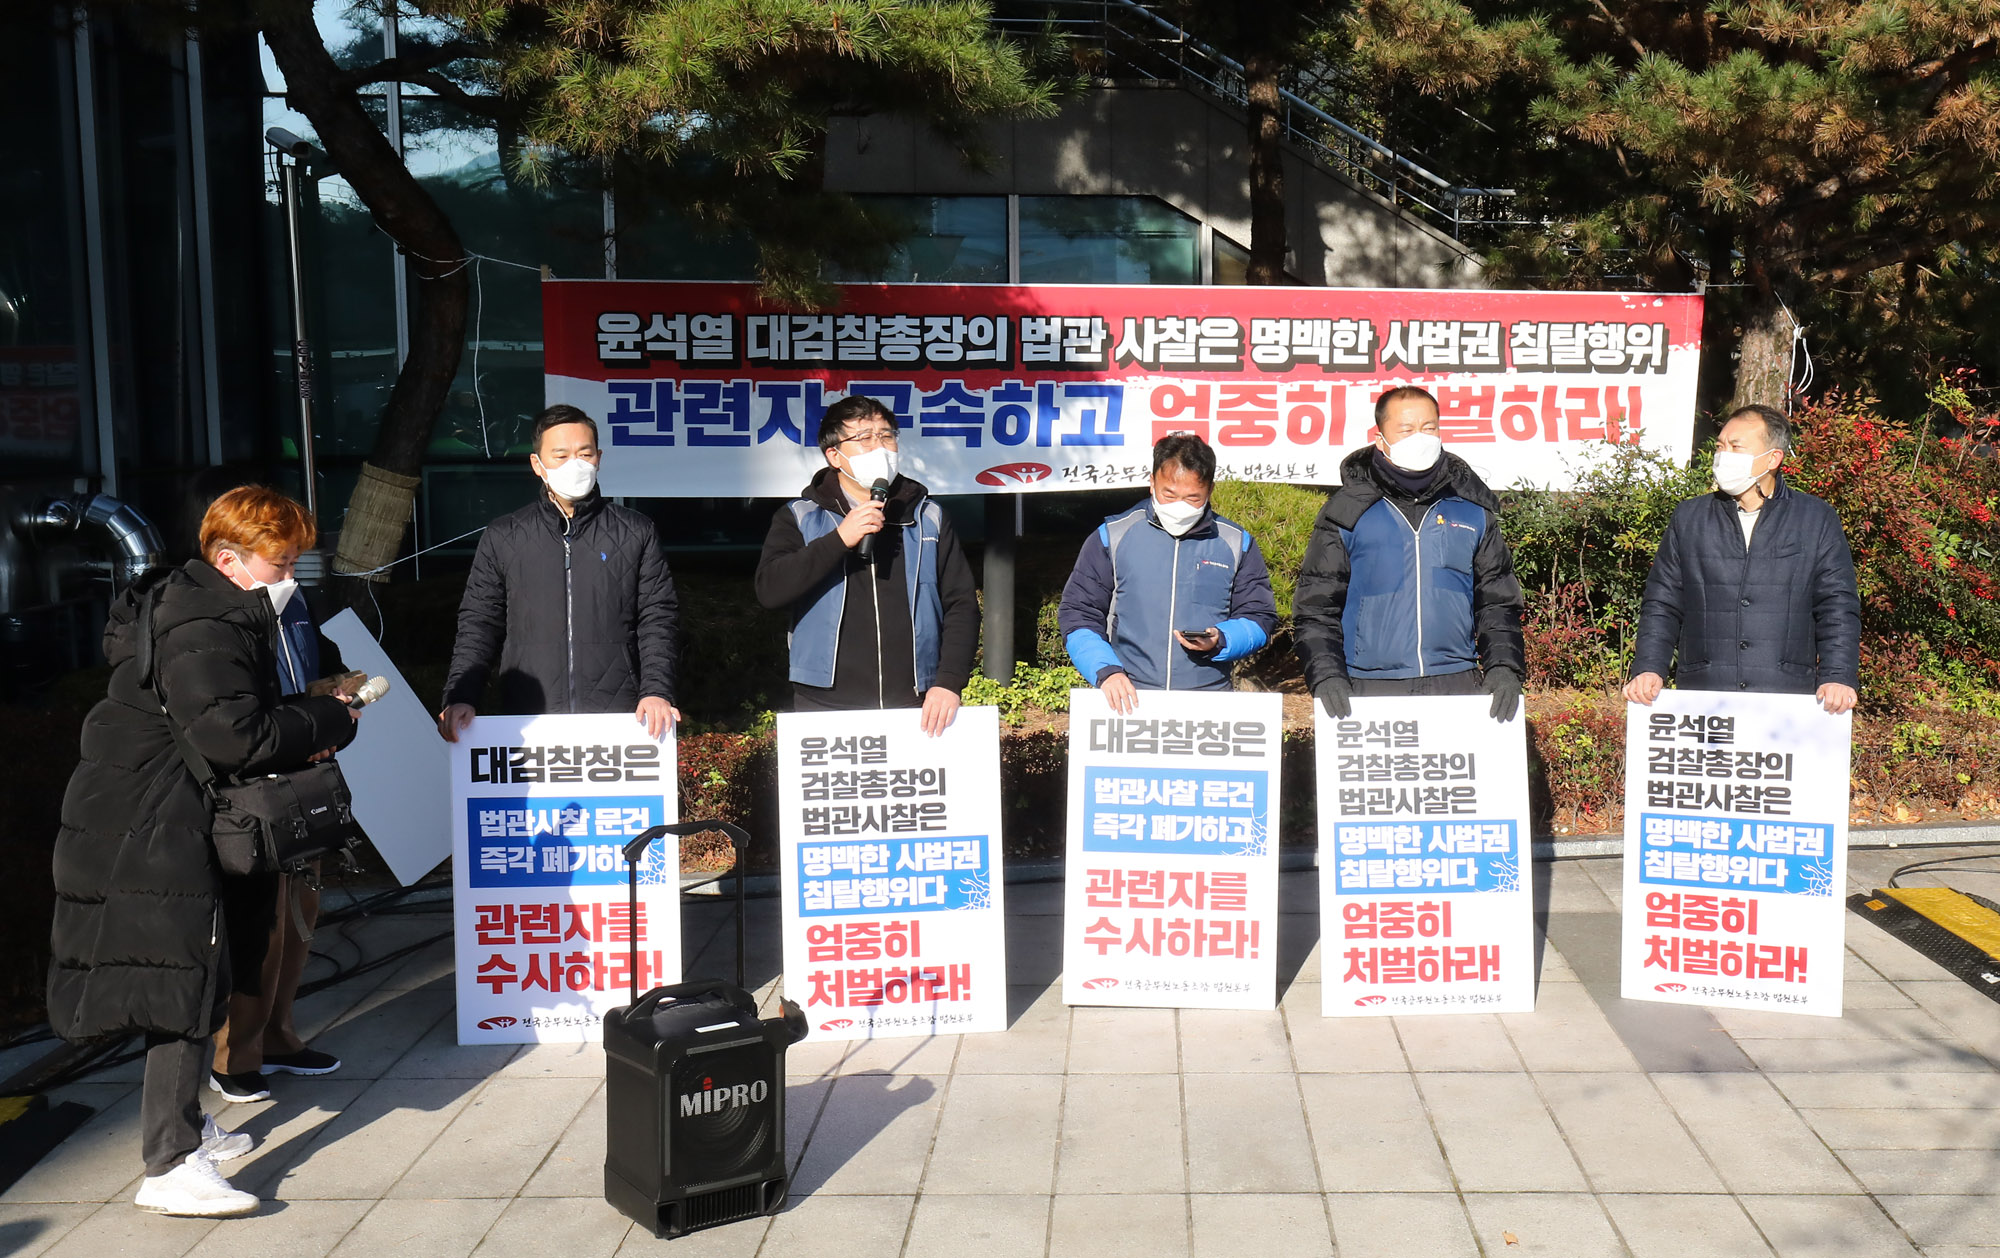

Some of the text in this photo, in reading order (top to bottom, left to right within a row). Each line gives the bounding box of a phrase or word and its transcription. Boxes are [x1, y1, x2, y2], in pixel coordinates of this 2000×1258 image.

[598, 313, 1663, 368] 윤석열 대검찰총장의 법관 사찰은 명백한 사법권 침탈행위
[607, 382, 820, 448] 관련자
[1150, 385, 1346, 447] 엄중히
[1366, 385, 1642, 445] 벌하라!
[1245, 463, 1320, 480] 법원본부
[1090, 718, 1266, 757] 대검찰청은
[1336, 720, 1419, 748] 윤석열
[1649, 713, 1735, 745] 윤석열
[470, 744, 659, 784] 대검찰청은
[801, 735, 887, 766] 윤석열
[1337, 752, 1476, 782] 검찰총장의
[1648, 747, 1793, 781] 검찰총장의
[802, 768, 946, 801] 검찰총장의
[1094, 778, 1254, 808] 법관사찰 문건
[1339, 786, 1477, 816] 법관사찰은
[1647, 780, 1792, 815] 법관사찰은
[479, 808, 649, 837] 법관사찰 문건
[802, 802, 947, 835] 법관사찰은
[1093, 812, 1252, 843] 즉각 폐기하고
[1339, 823, 1510, 855] 명백한 사법권
[1645, 817, 1825, 857] 명백한 사법권
[480, 845, 650, 874] 즉각 폐기하고
[802, 840, 981, 876] 명백한 사법권
[1339, 857, 1479, 889] 침탈행위다
[1644, 850, 1789, 887] 침탈행위다
[803, 875, 948, 910] 침탈행위다
[1085, 868, 1247, 911] 관련자를
[475, 902, 648, 945] 관련자를
[1342, 900, 1452, 939] 엄중히
[1645, 891, 1758, 936] 엄중히
[806, 920, 920, 963] 엄중히
[1084, 916, 1260, 959] 수사하라!
[476, 950, 662, 994] 수사하라!
[1343, 944, 1500, 984] 처벌하라!
[1644, 935, 1808, 984] 처벌하라!
[808, 963, 971, 1008] 처벌하라!
[522, 1015, 604, 1029] 전국공무원노동조
